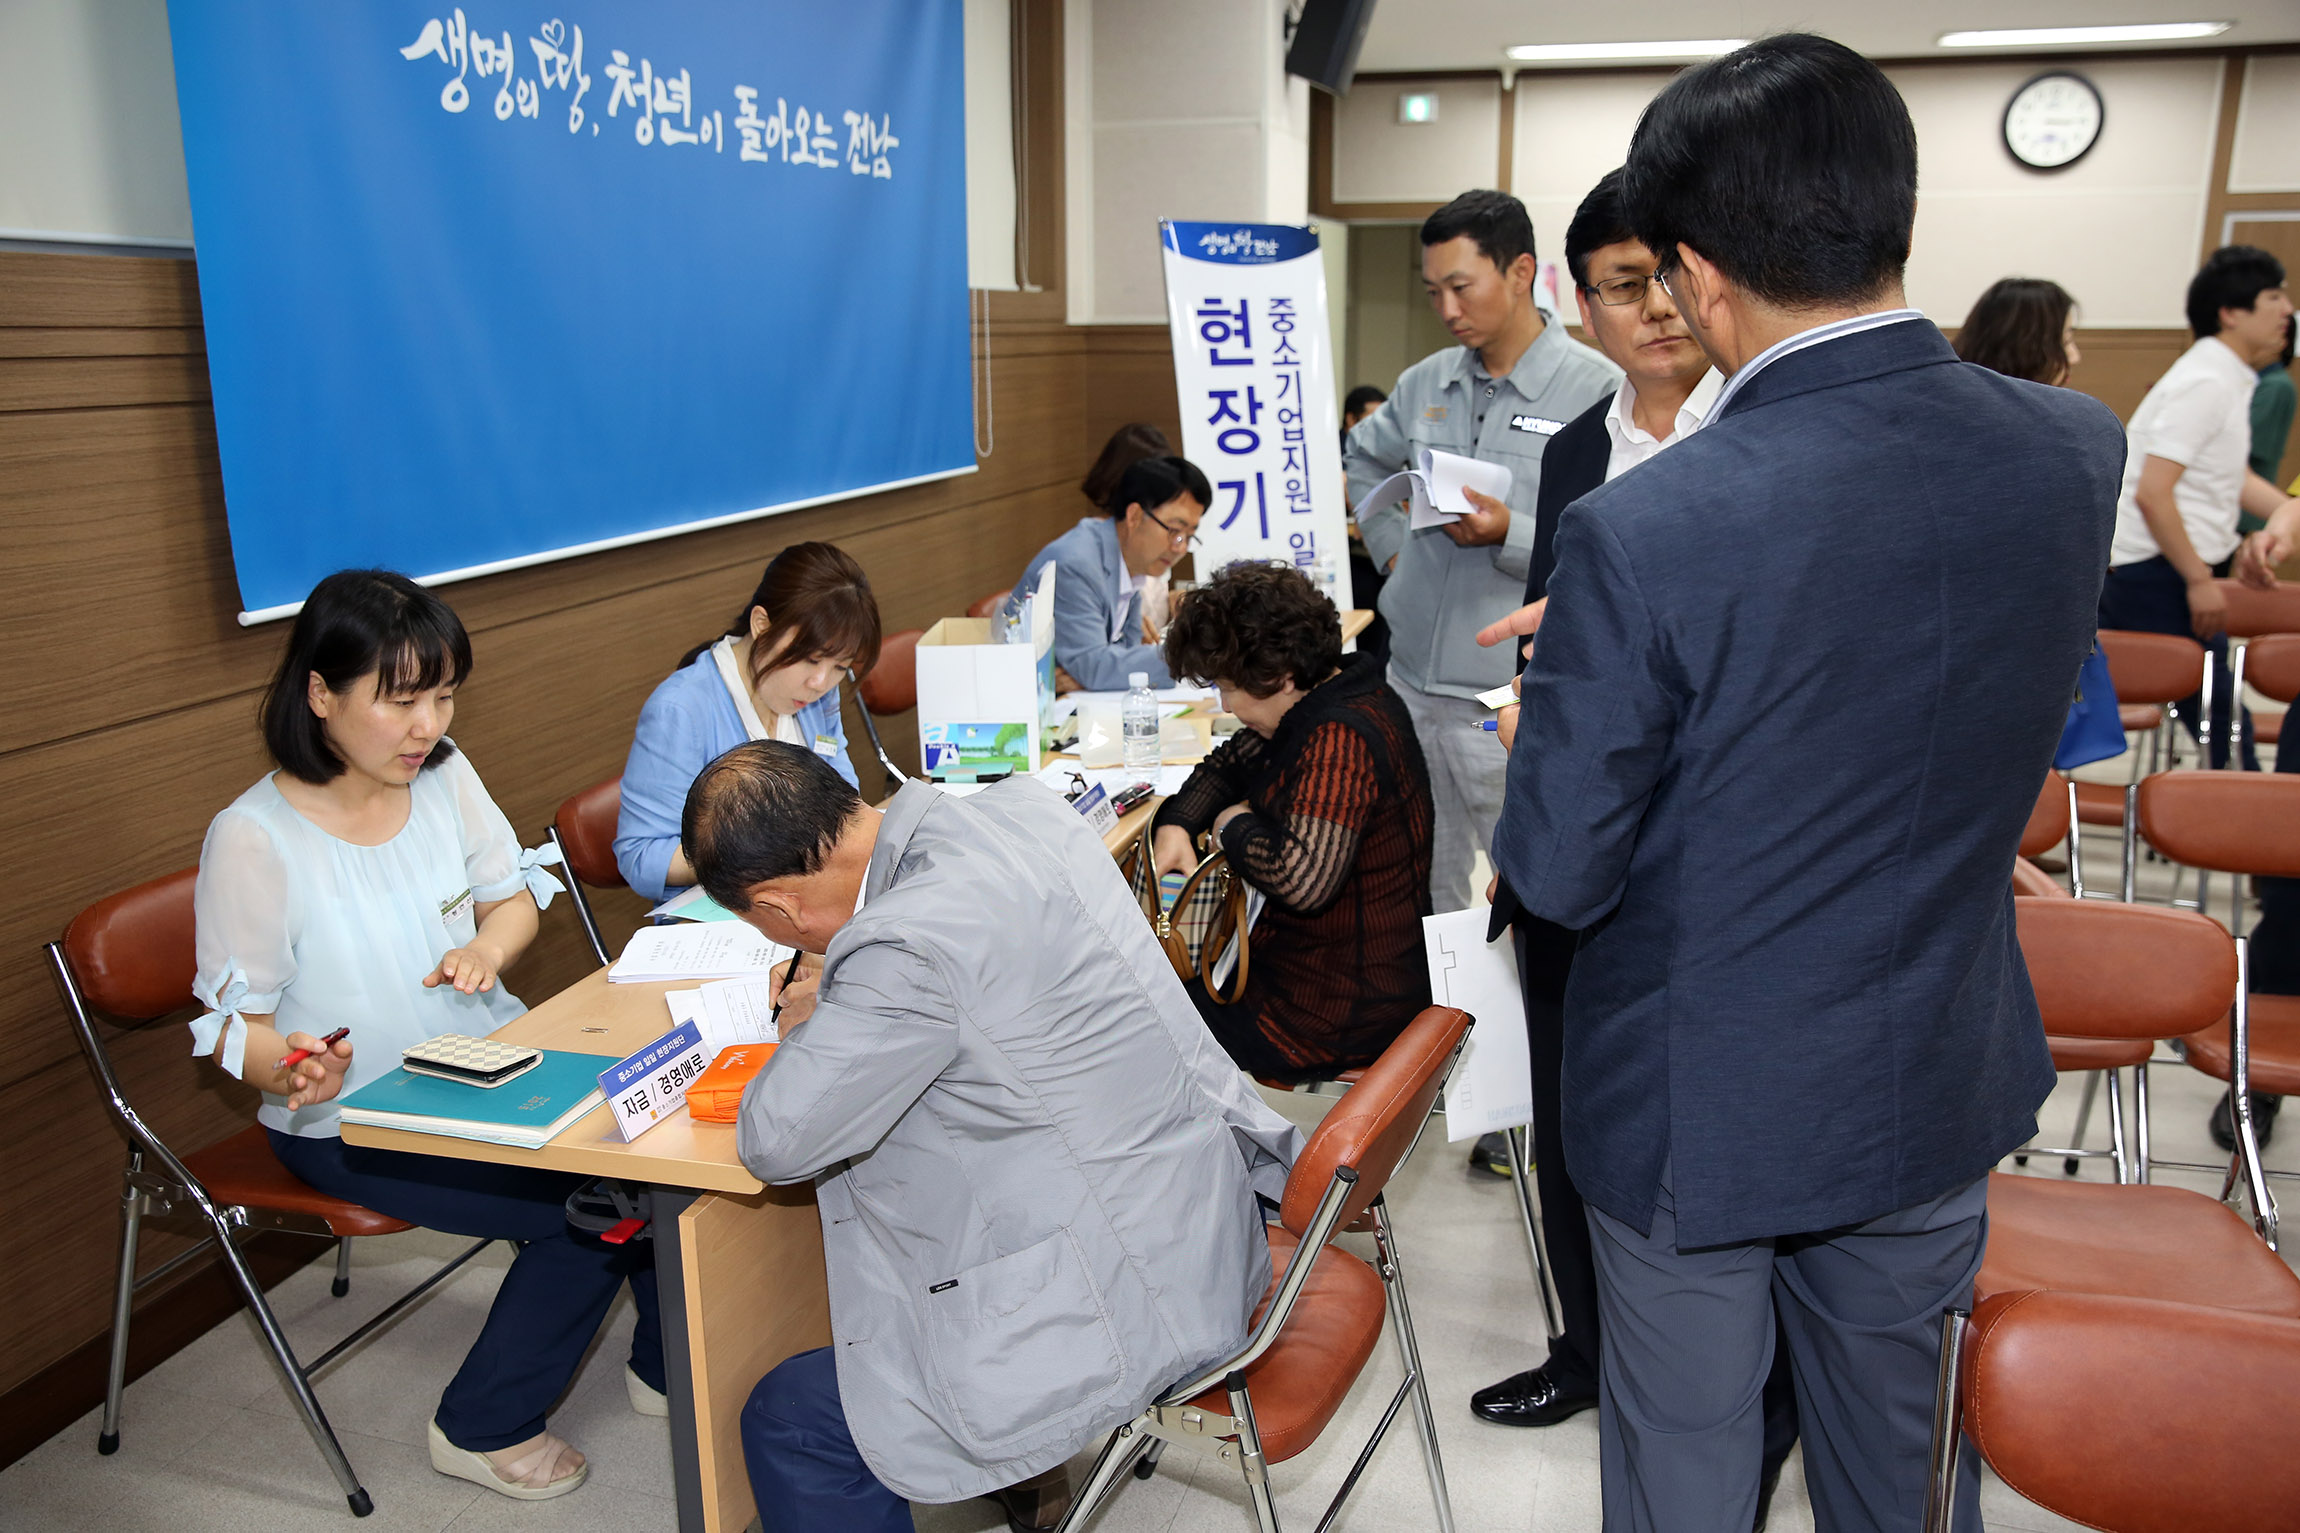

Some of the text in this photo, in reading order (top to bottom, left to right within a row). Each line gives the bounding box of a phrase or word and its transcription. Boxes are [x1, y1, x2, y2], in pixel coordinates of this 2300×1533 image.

[604, 49, 722, 153] 청년이
[734, 84, 839, 168] 돌아오는
[843, 109, 900, 179] 전남
[1268, 298, 1312, 514] 중소기업지원
[617, 1034, 686, 1083] 중소기업 일일 현장지원단
[622, 1089, 651, 1118] 자금
[658, 1052, 706, 1096] 경영애로
